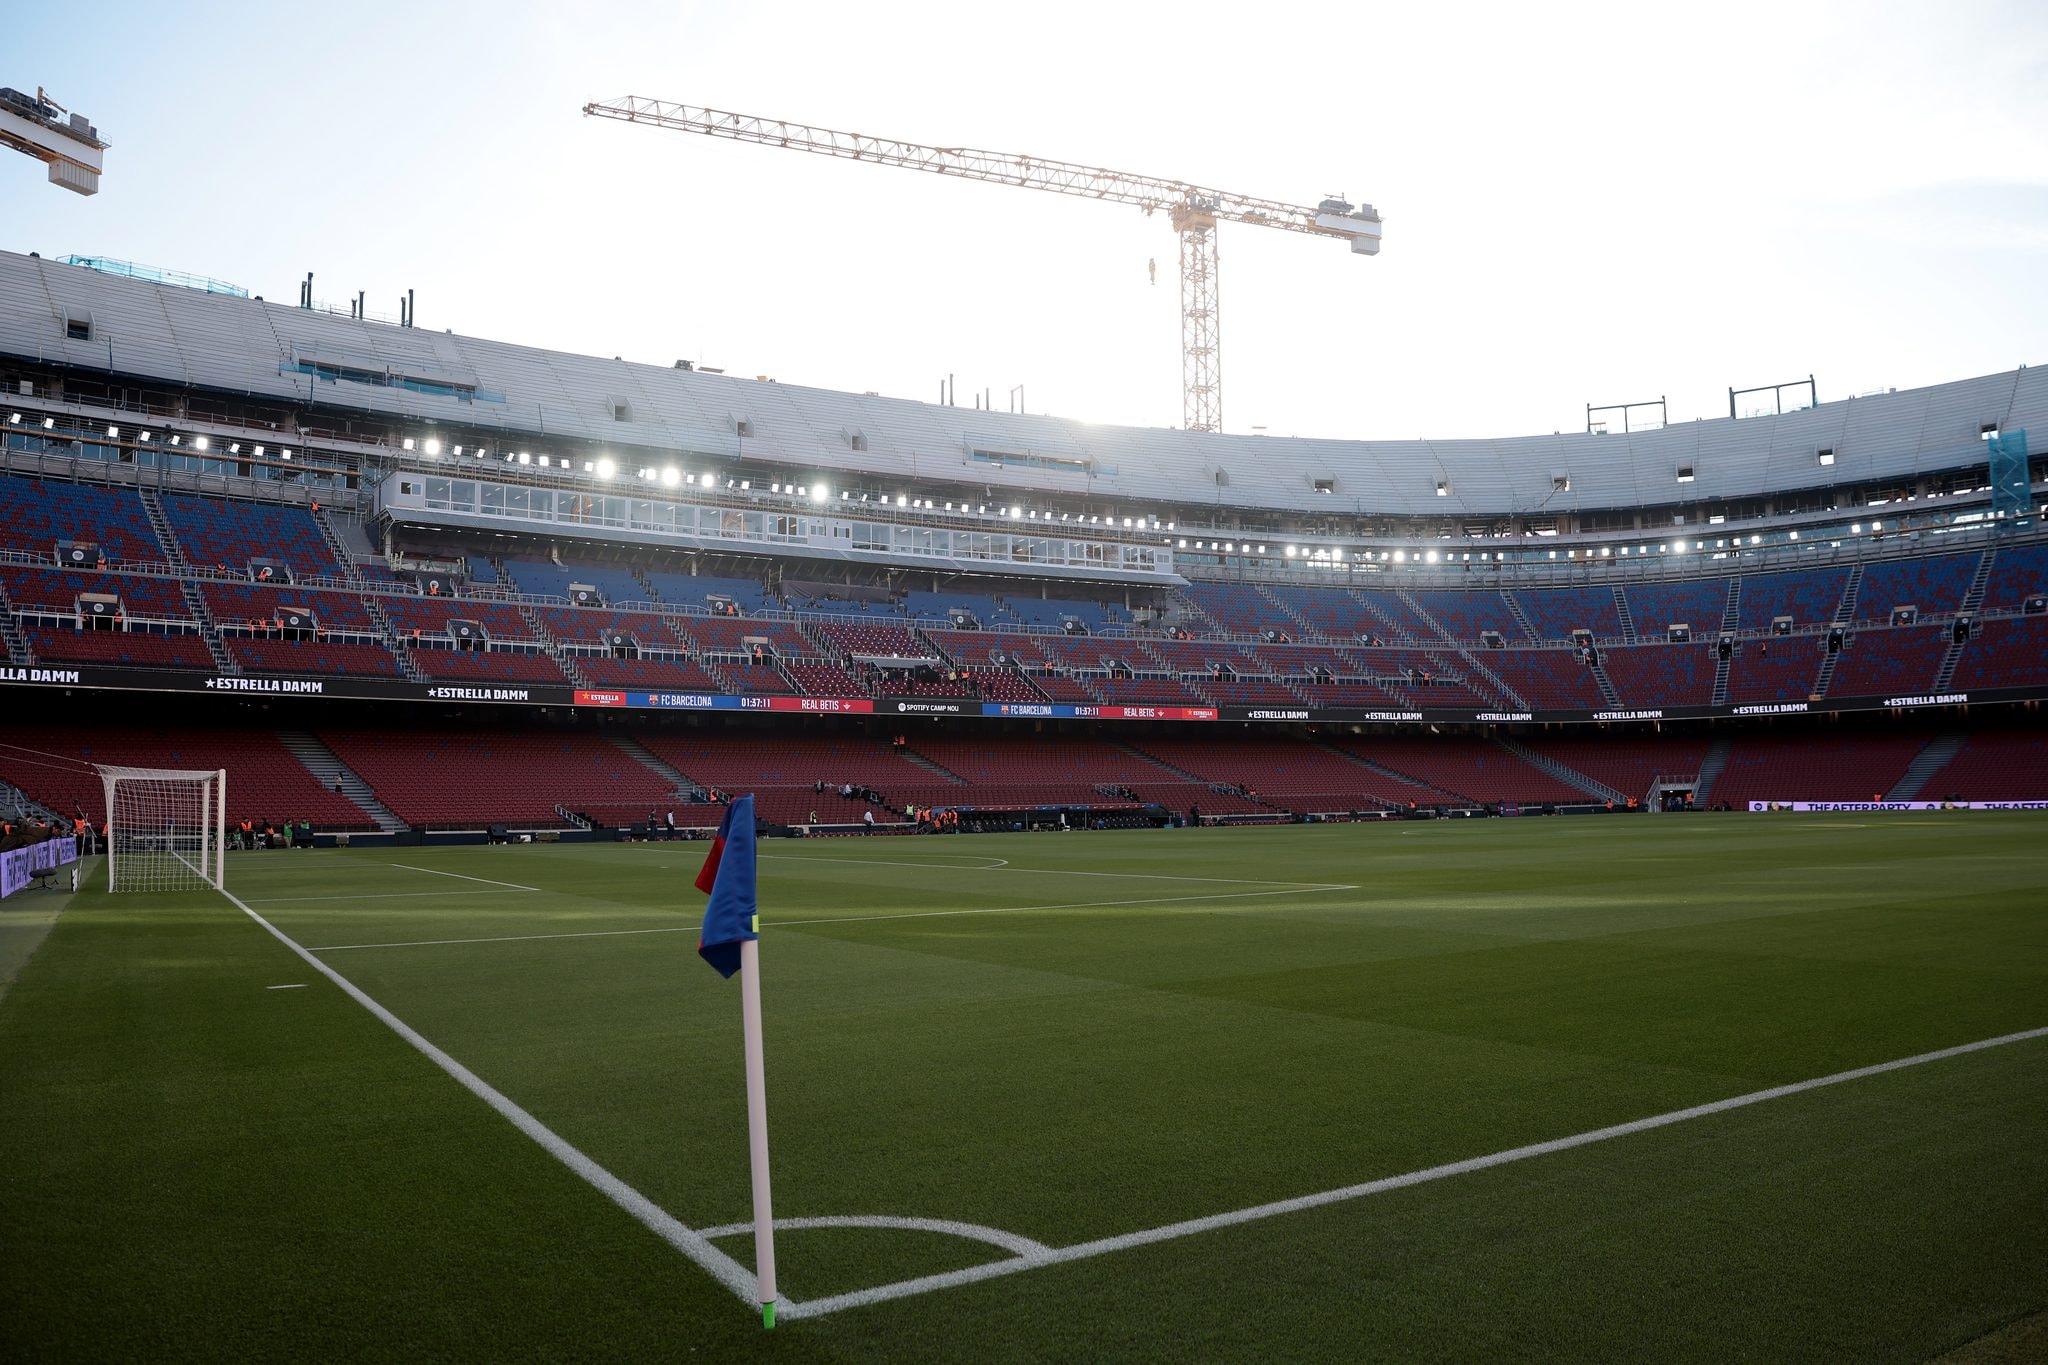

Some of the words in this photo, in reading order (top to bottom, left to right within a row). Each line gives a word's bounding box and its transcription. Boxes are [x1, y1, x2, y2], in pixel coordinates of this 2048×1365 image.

[30, 669, 79, 683] DAMM
[216, 677, 279, 691] ESTRELLA
[282, 680, 323, 693] DAMM
[437, 687, 491, 700] ESTRELLA
[493, 689, 529, 701] DAMM
[661, 694, 672, 705] FC
[673, 695, 713, 706] BARCELONA
[741, 697, 771, 708] 01:37:11
[801, 699, 818, 709] REAL
[819, 700, 839, 710] BETIS
[1891, 695, 1936, 706] ESTRELLA
[1937, 693, 1967, 704] DAMM
[1010, 705, 1018, 715] FC
[1019, 705, 1052, 715] BARCELONA
[1075, 706, 1099, 716] 01:37:11
[1124, 707, 1138, 717] REAL
[1138, 708, 1155, 717] BETIS
[1739, 704, 1779, 714] ESTRELLA
[1780, 703, 1807, 712] DAMM
[1253, 710, 1287, 718] ESTRELLA
[1287, 711, 1308, 719] DAMM
[1370, 712, 1401, 720] ESTRELLA
[1401, 712, 1423, 720] DAMM
[1481, 713, 1510, 721] ESTRELLA
[1510, 713, 1532, 721] DAMM
[1599, 711, 1635, 720] ESTRELLA
[1637, 710, 1662, 718] DAMM
[1871, 803, 1911, 811] PARTY
